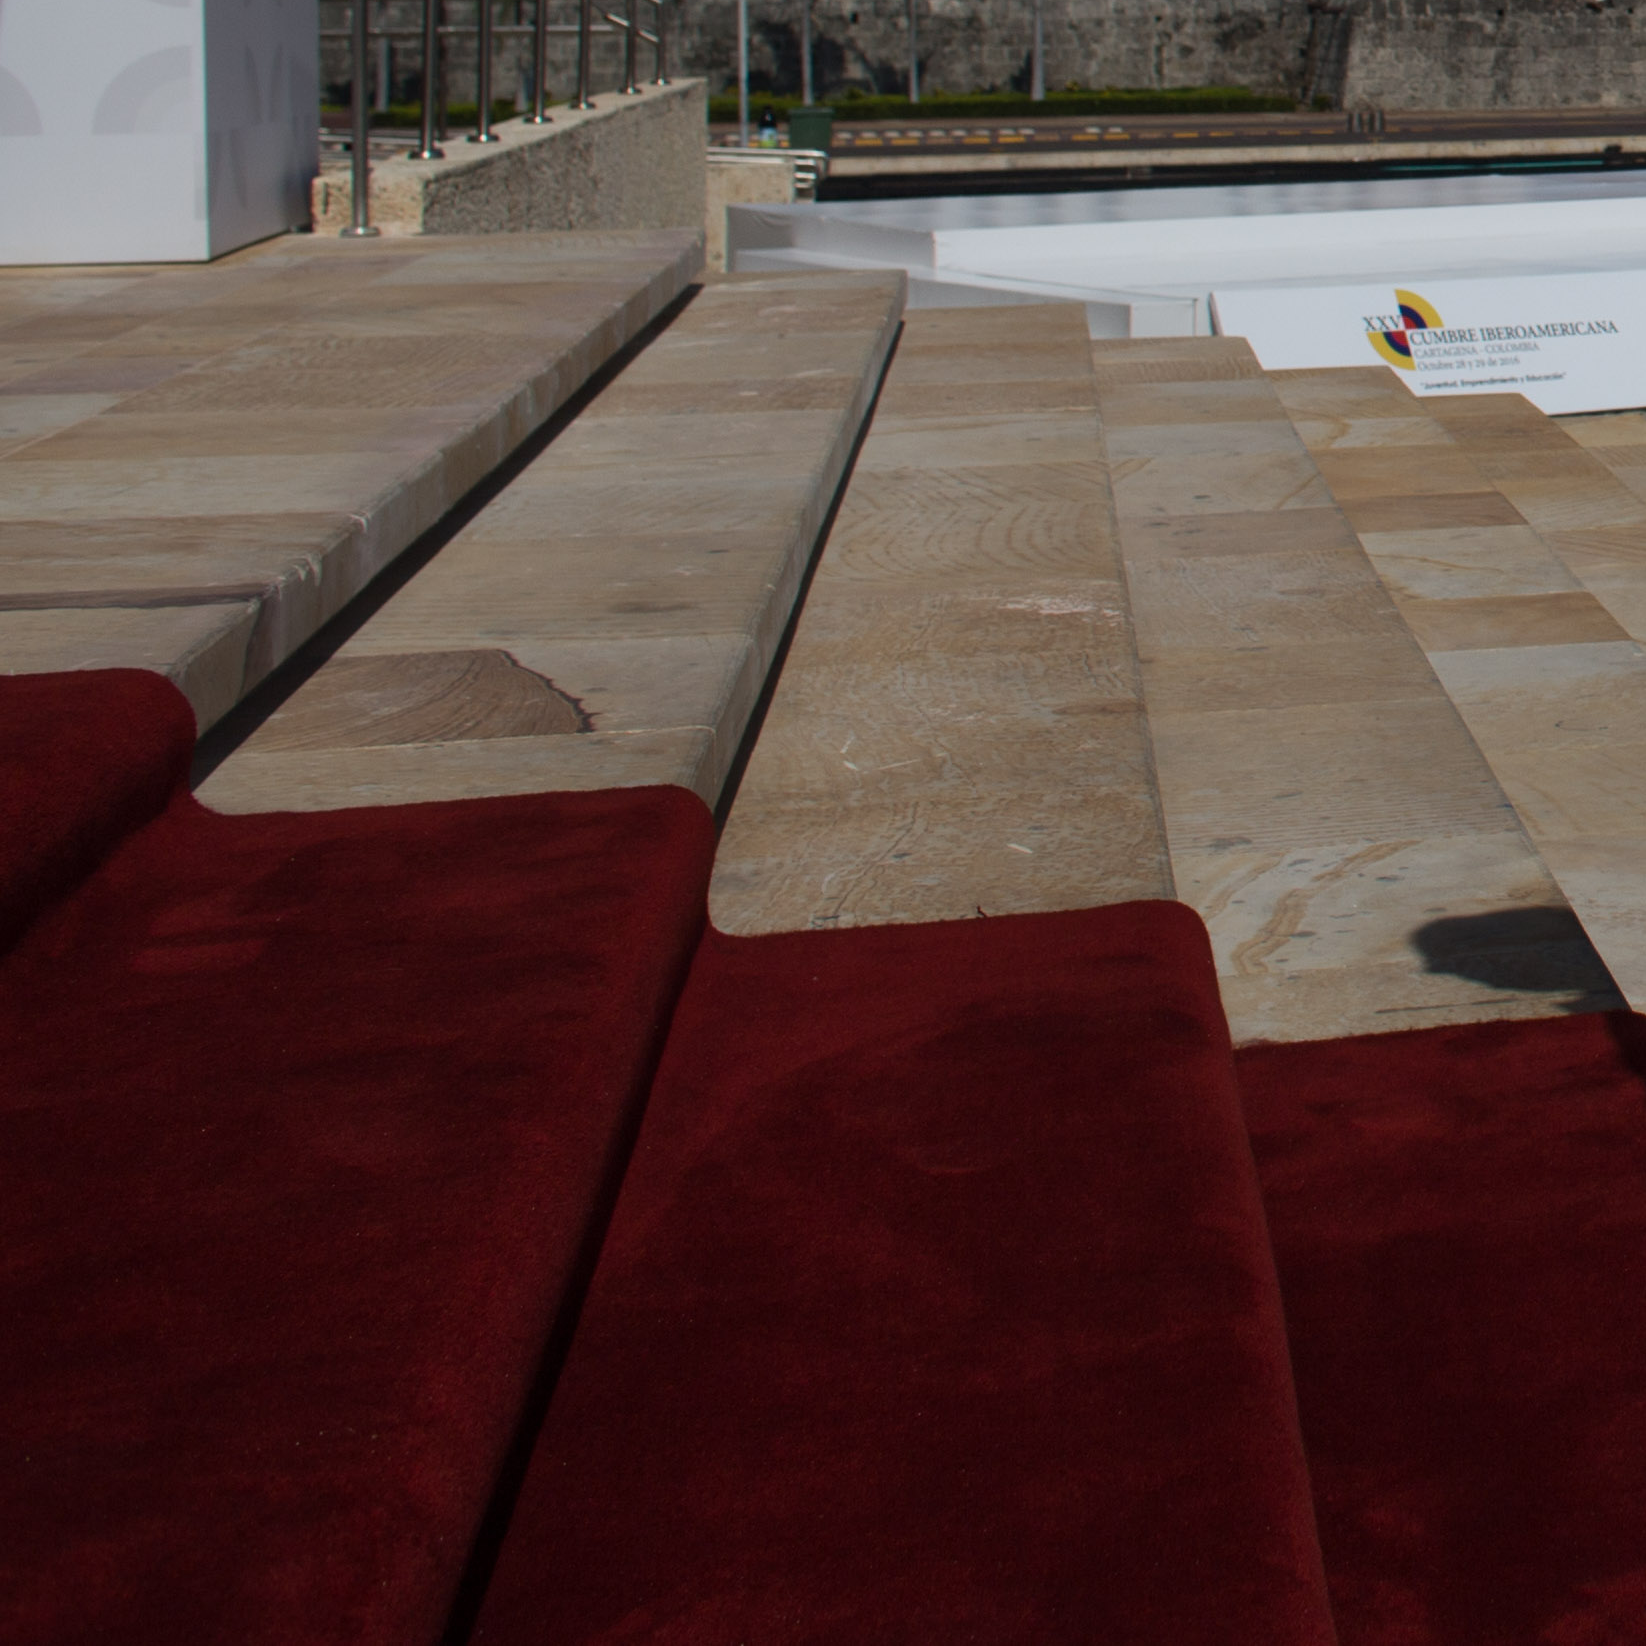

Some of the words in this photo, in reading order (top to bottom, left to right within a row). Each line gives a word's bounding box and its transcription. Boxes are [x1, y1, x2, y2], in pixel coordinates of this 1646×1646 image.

[1362, 314, 1402, 332] XXV
[1409, 328, 1478, 345] CUMBRE
[1479, 320, 1619, 342] IBEROAMERICANA
[1414, 344, 1478, 358] CARTAGENA
[1485, 341, 1540, 354] COLOMBIA
[1417, 359, 1454, 371] Octubre
[1456, 359, 1466, 369] 28
[1468, 360, 1474, 370] y
[1487, 357, 1498, 367] de
[1499, 355, 1520, 366] 2016
